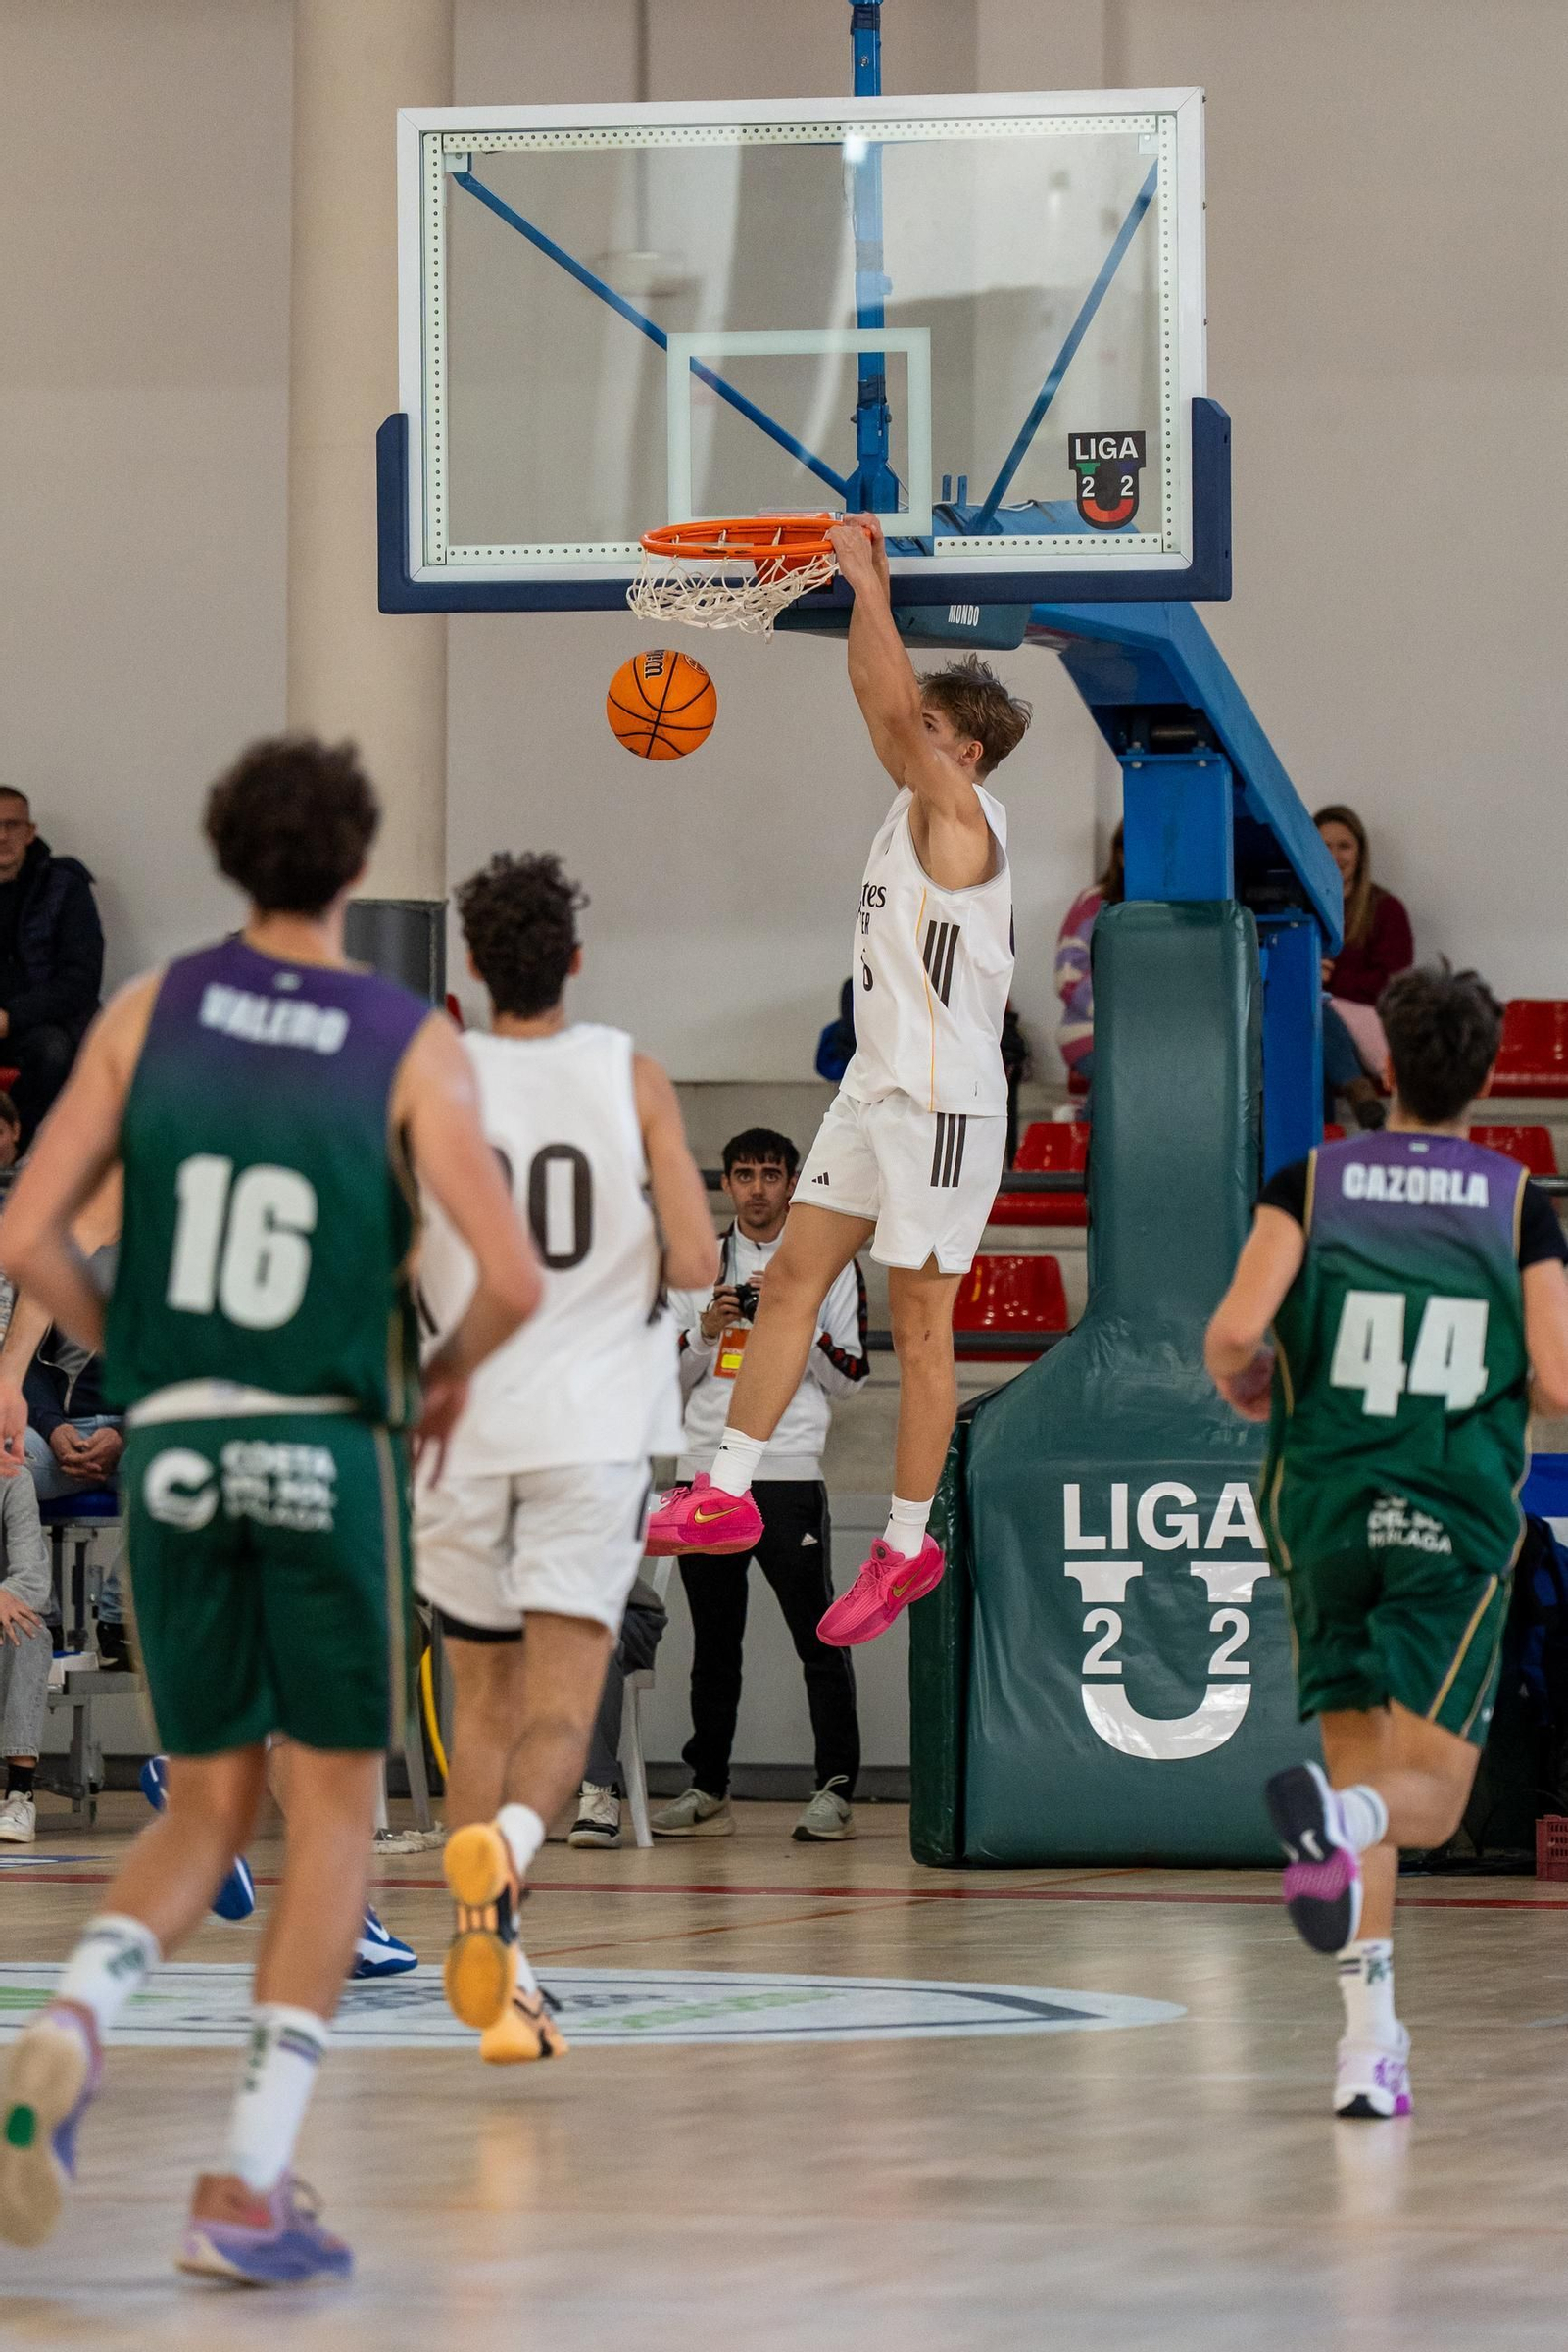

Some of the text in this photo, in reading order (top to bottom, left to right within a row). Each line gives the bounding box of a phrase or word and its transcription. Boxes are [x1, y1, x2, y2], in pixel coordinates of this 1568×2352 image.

[1075, 437, 1139, 460] LIGA
[948, 604, 980, 627] MONDO
[166, 1152, 318, 1331] 16
[1329, 1289, 1490, 1419] 44
[1063, 1481, 1268, 1550] LIGA
